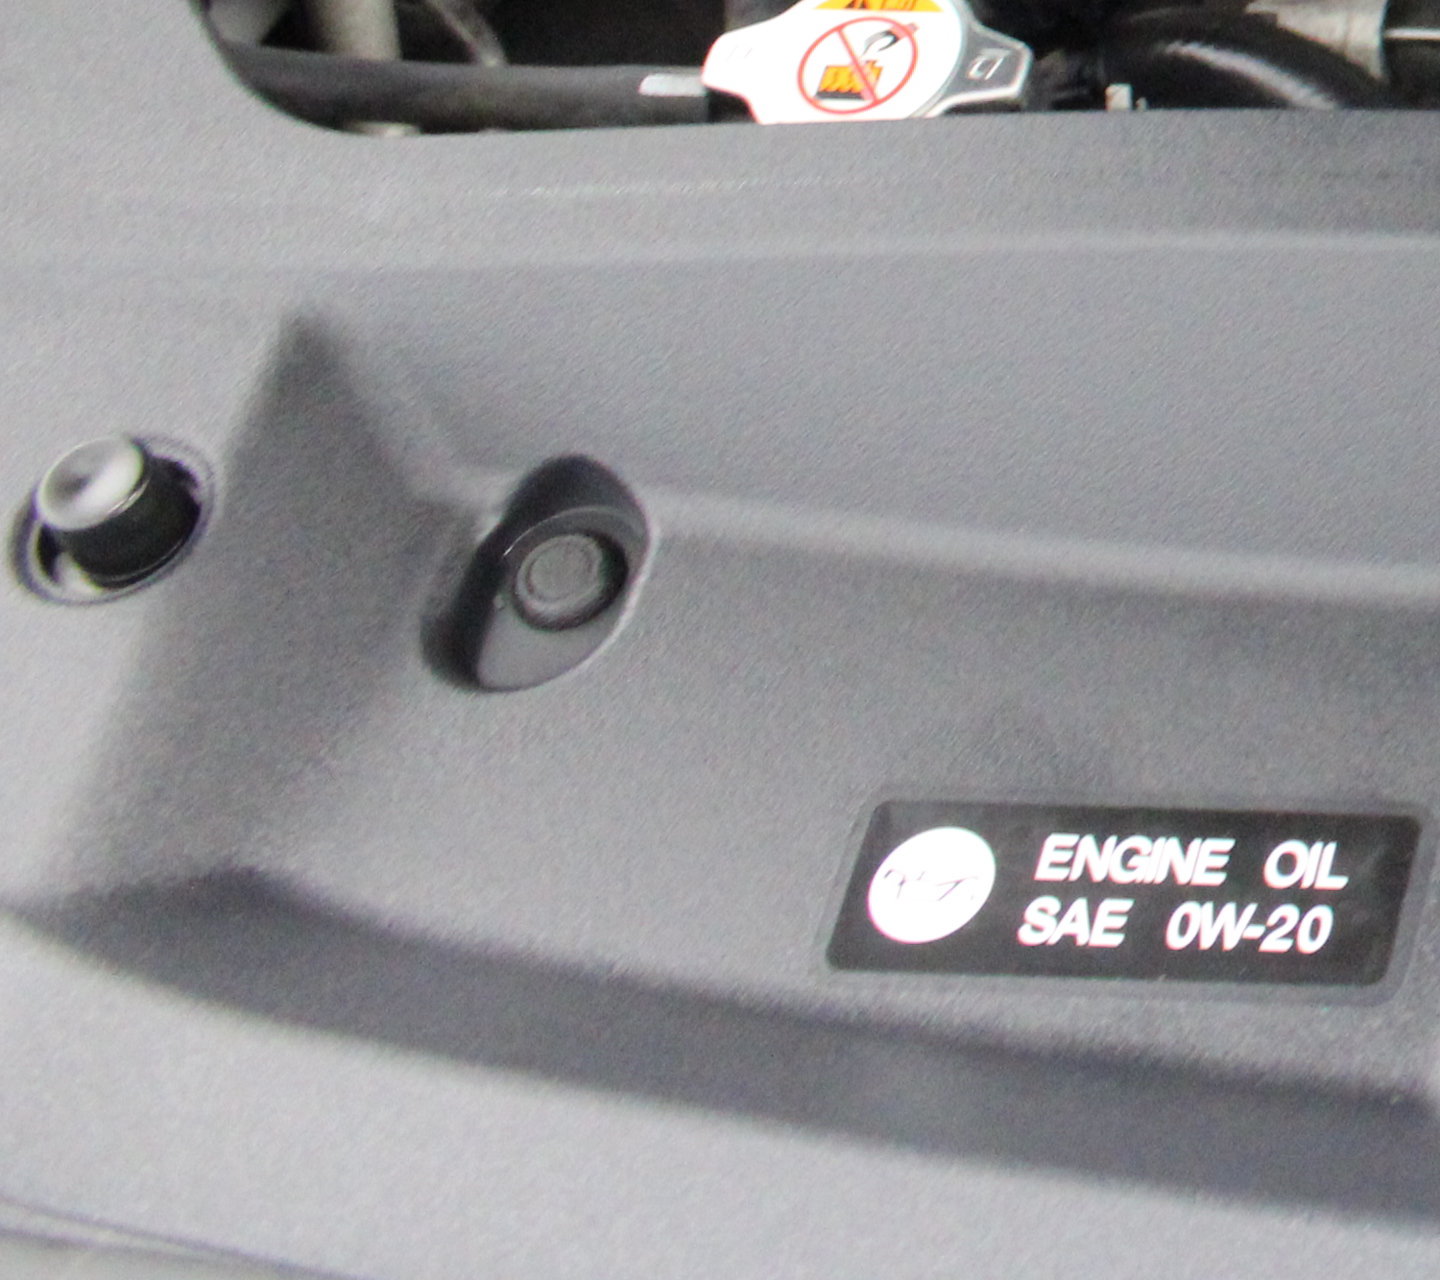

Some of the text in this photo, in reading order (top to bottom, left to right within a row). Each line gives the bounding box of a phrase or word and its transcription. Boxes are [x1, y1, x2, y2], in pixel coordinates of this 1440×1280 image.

[1034, 832, 1349, 890] ENGINE OIL
[1017, 895, 1335, 955] SAE 0W-20
